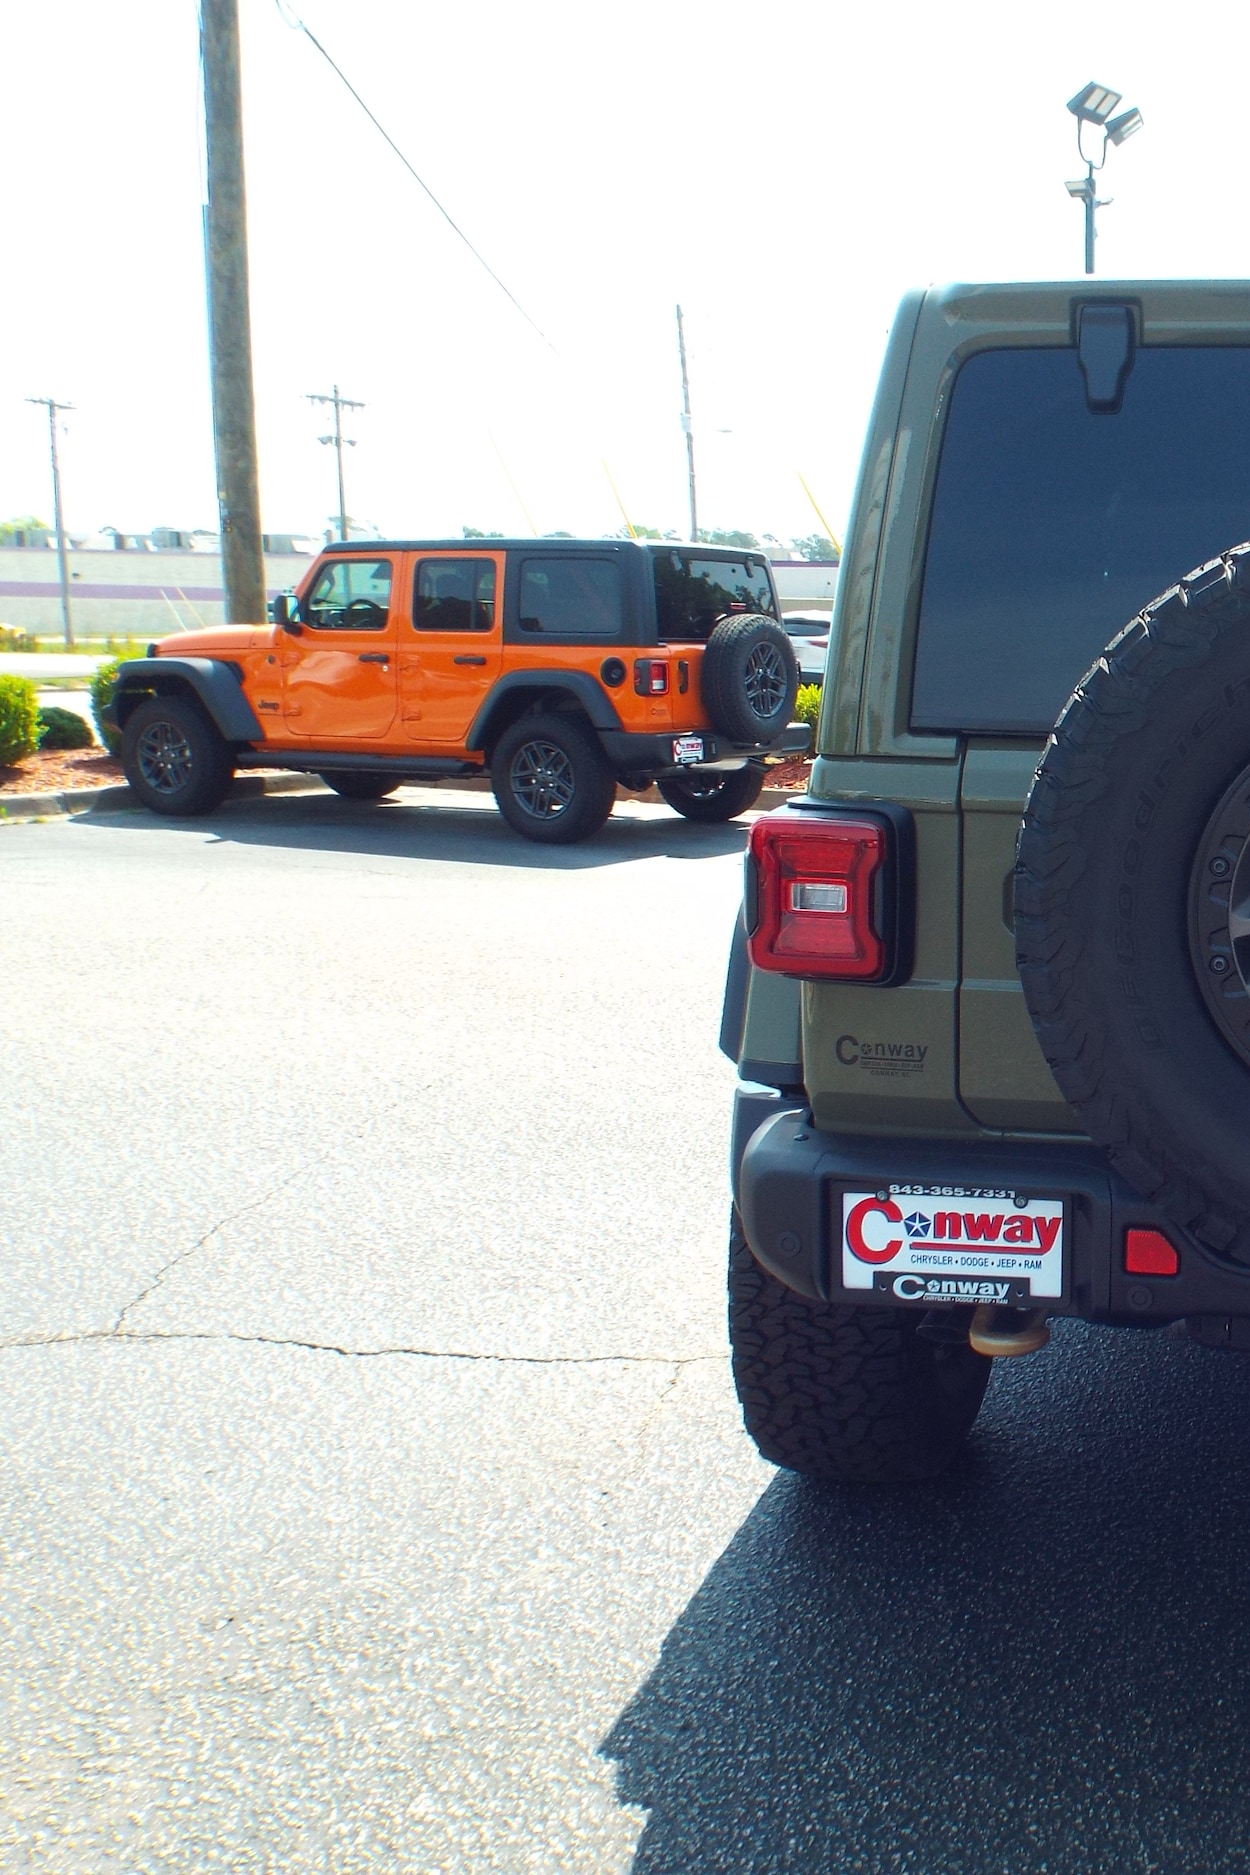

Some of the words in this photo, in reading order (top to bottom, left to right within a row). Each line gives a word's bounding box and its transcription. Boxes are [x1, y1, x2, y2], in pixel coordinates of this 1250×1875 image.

[836, 1035, 929, 1065] Conway
[889, 1184, 1016, 1199] 843-365-7331
[846, 1198, 1062, 1264] Conway
[910, 1254, 953, 1266] CHRYSLER
[960, 1256, 989, 1267] DODGE
[996, 1258, 1017, 1268] JEEP
[1024, 1260, 1042, 1269] RAM
[893, 1274, 1010, 1300] Conway
